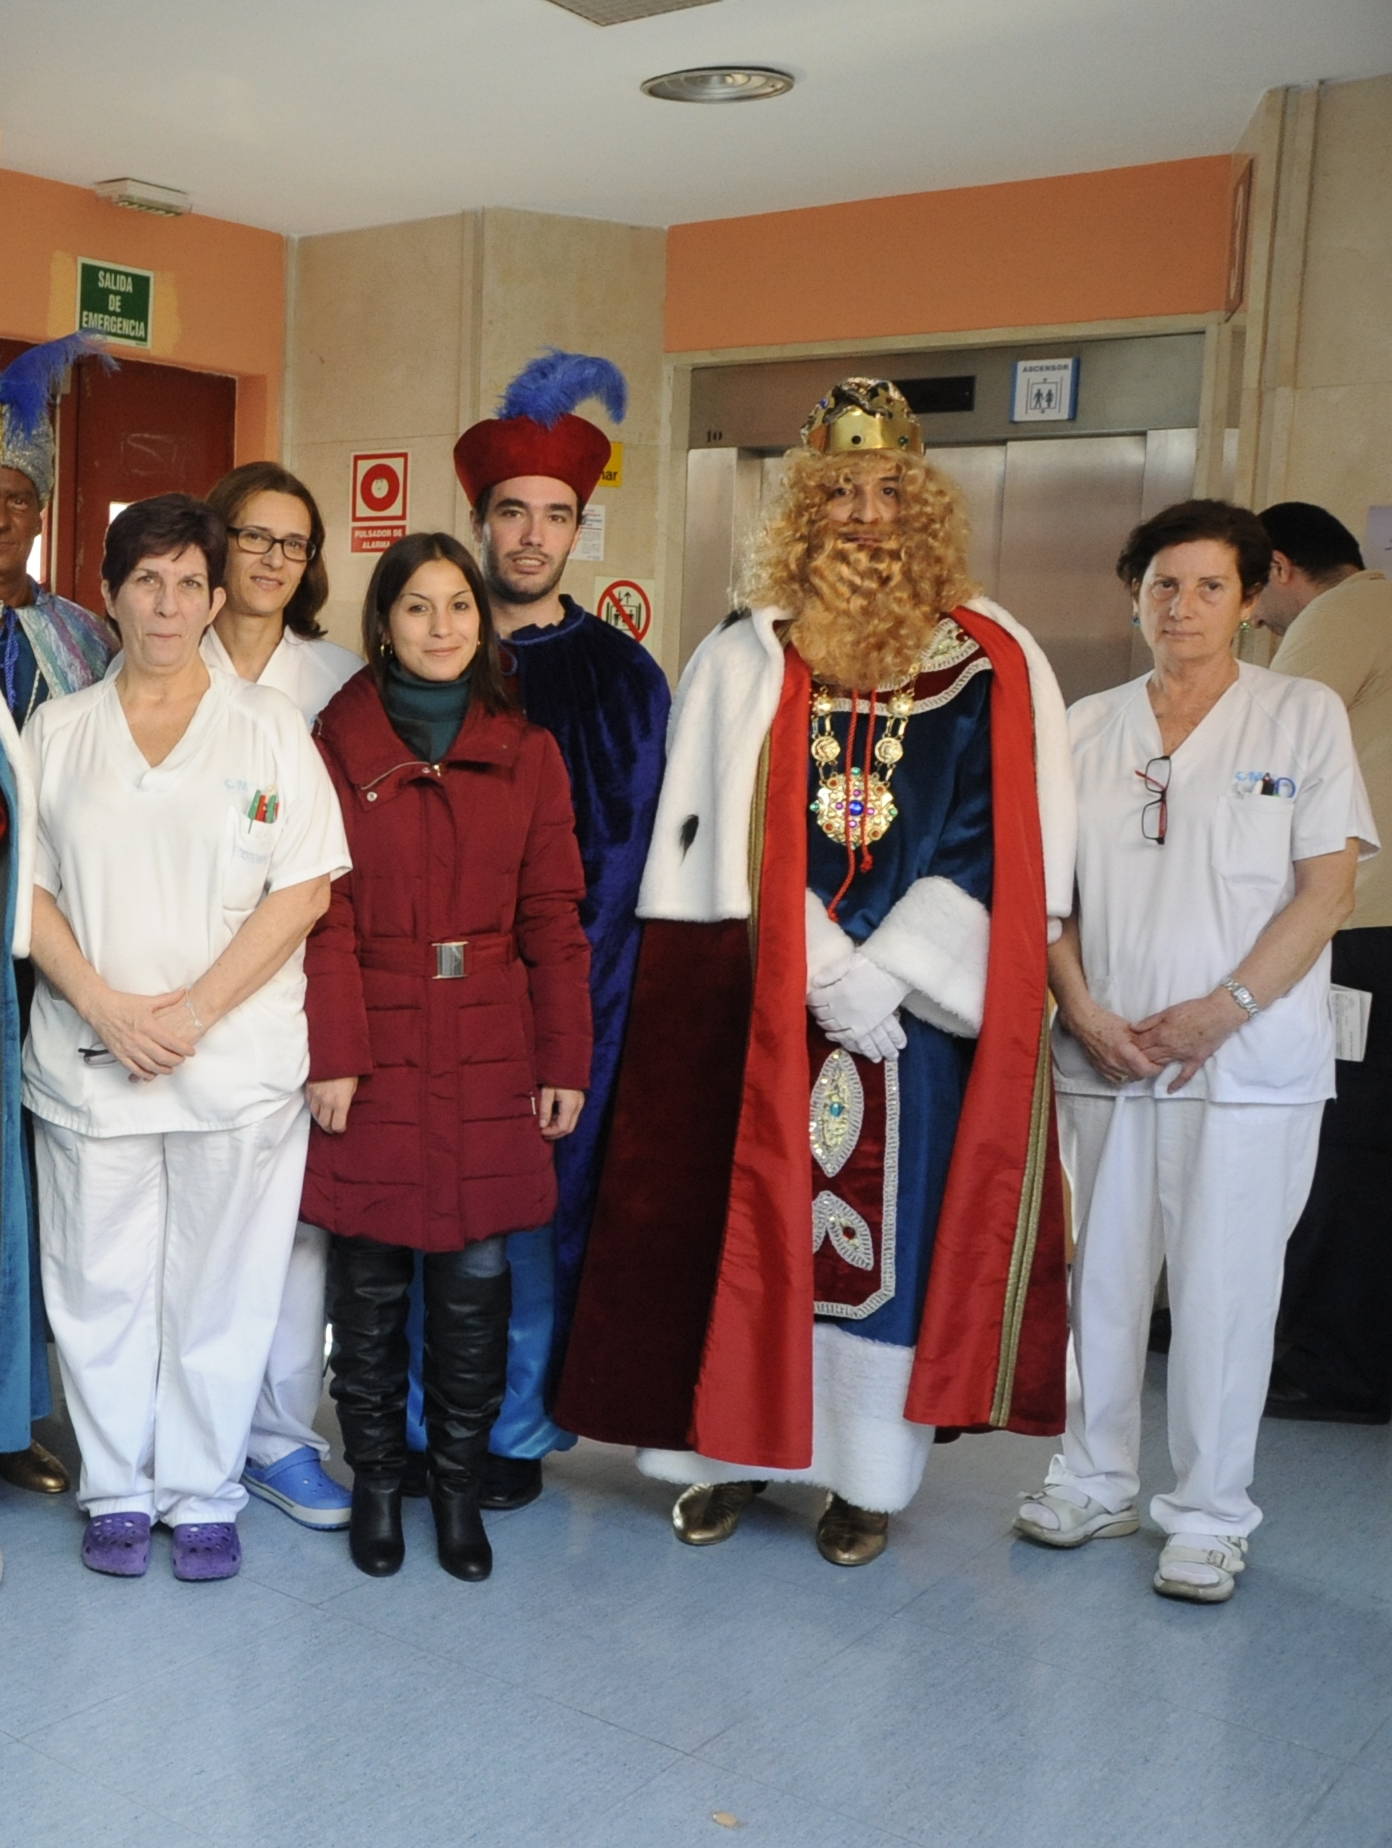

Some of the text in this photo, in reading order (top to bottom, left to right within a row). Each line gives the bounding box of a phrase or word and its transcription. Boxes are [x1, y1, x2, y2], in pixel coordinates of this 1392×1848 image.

[98, 270, 133, 293] SALIDA
[108, 294, 122, 312] DE
[82, 310, 145, 338] EMERGENCIA
[1022, 364, 1069, 373] ASCENSOR
[706, 430, 723, 442] 10
[354, 528, 403, 539] PULSADOR DE
